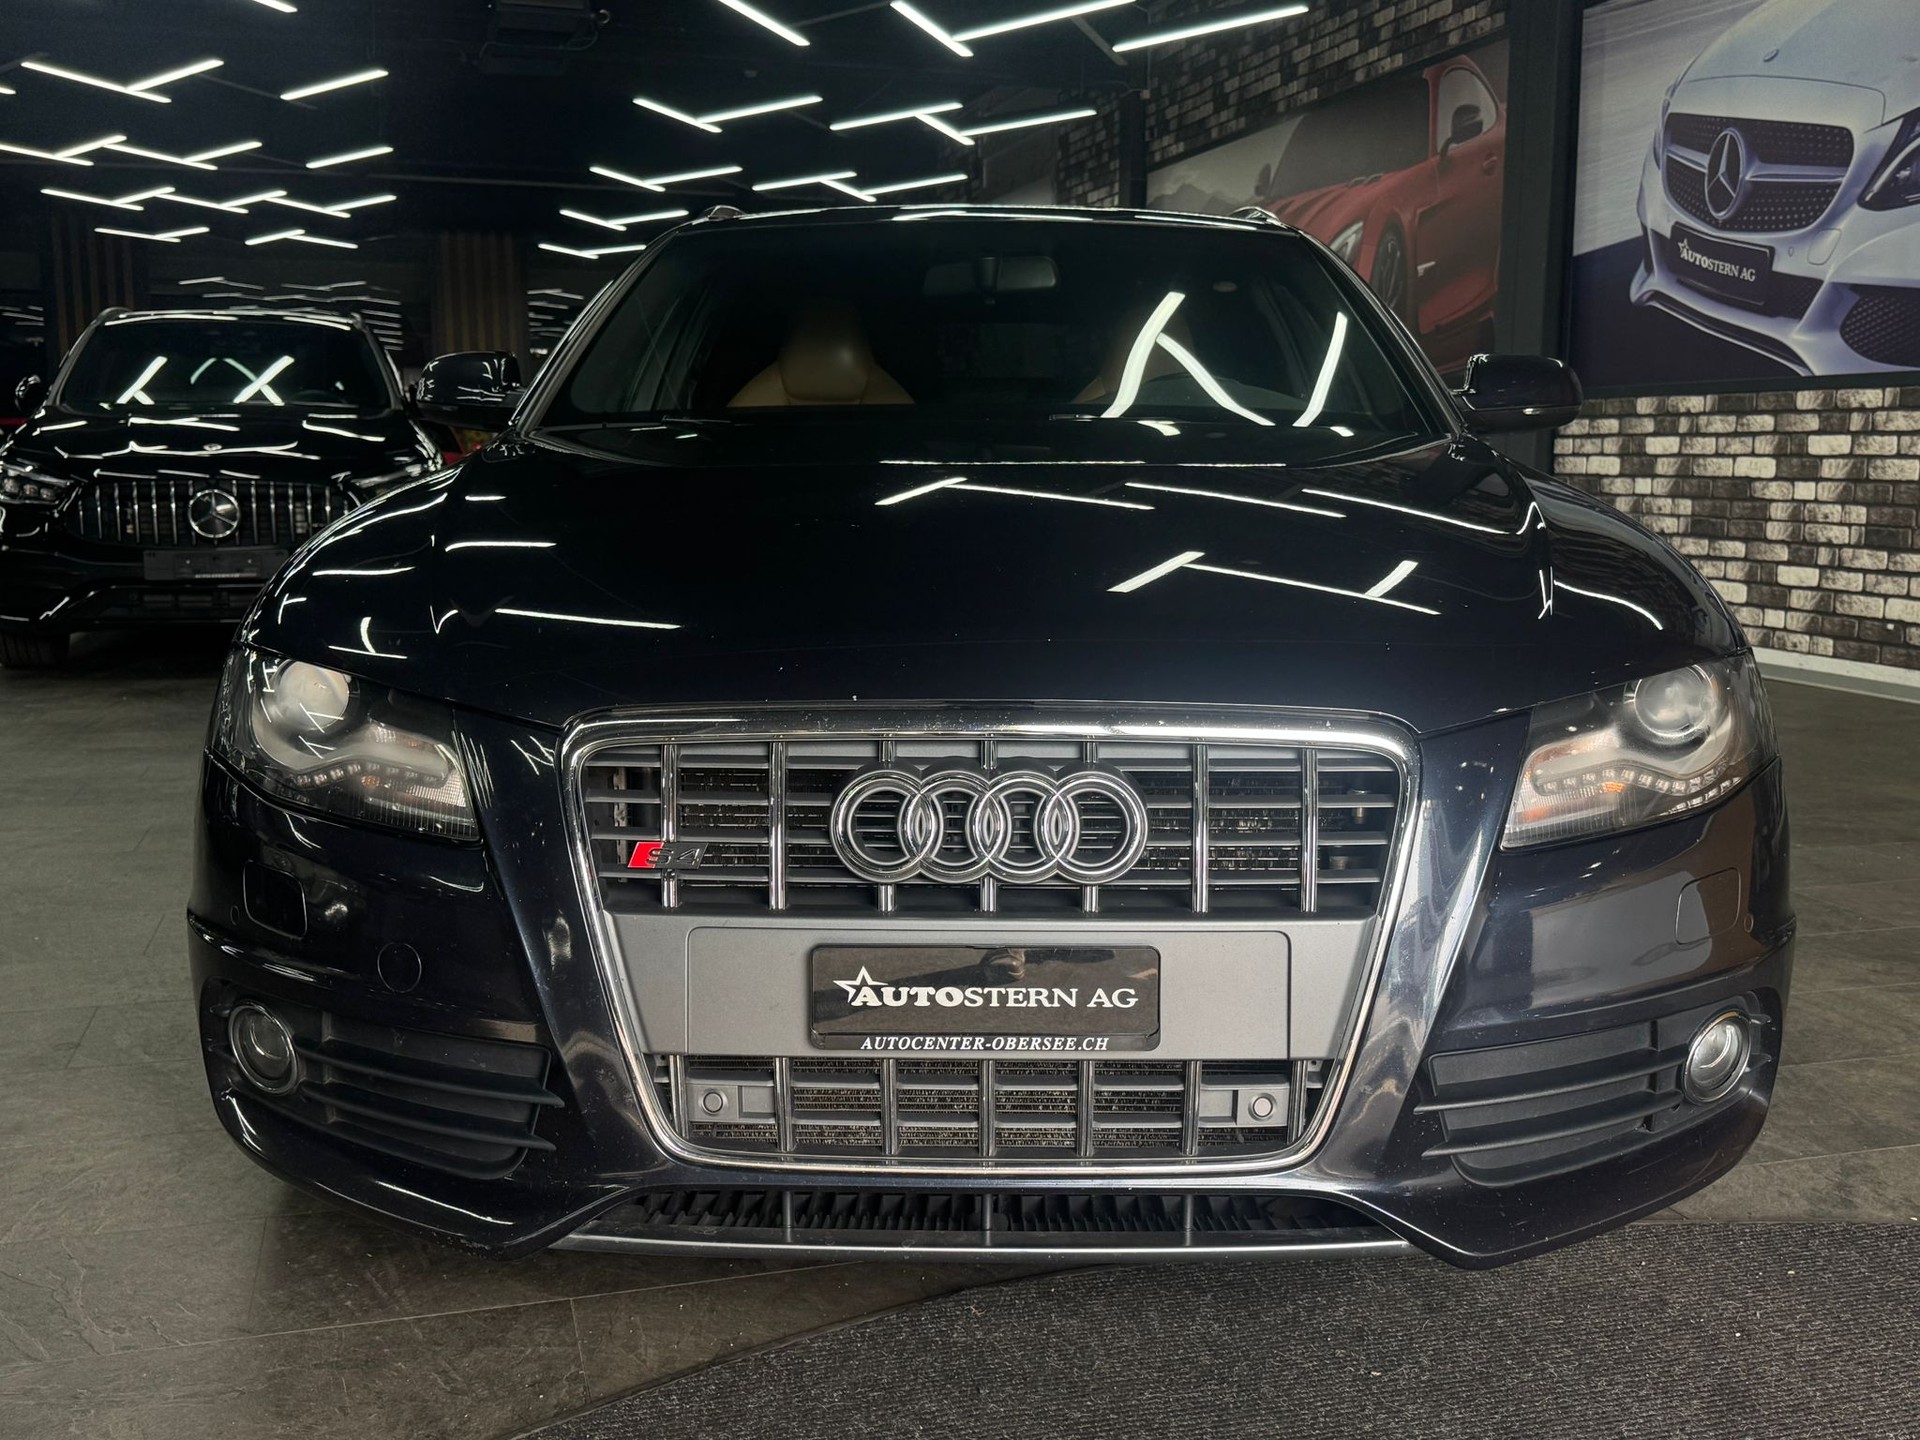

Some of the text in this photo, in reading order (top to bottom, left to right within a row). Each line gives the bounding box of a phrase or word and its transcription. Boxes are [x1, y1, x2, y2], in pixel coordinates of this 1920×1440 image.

[1680, 248, 1756, 282] AUTOSTERN AG
[850, 986, 1139, 1009] AUTOSTERN AG
[860, 1036, 1110, 1051] AUTOCENTER-OBERSEE.CH
